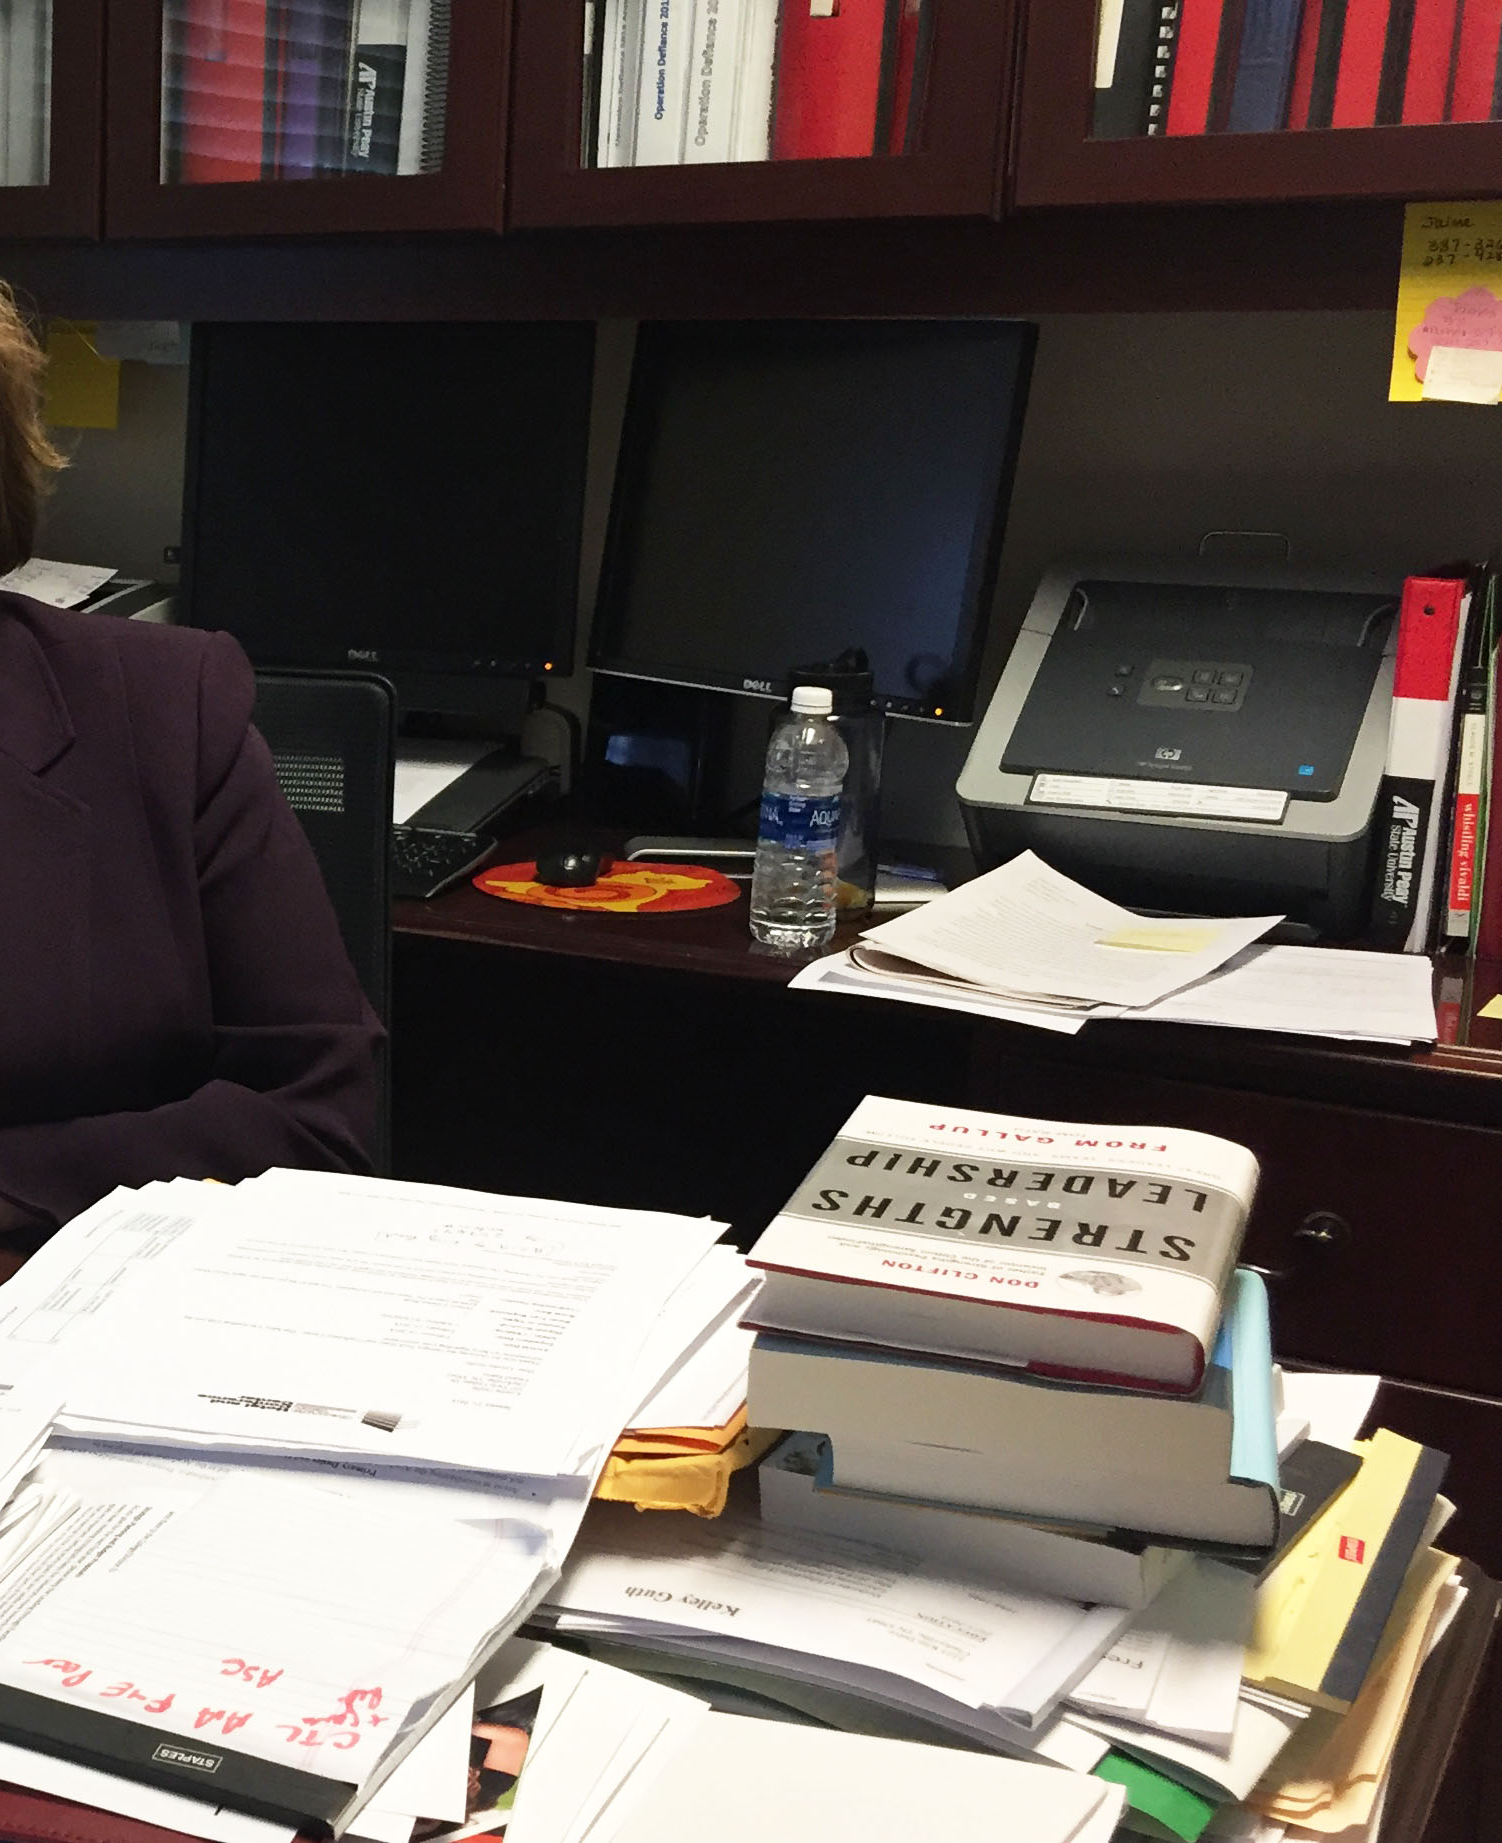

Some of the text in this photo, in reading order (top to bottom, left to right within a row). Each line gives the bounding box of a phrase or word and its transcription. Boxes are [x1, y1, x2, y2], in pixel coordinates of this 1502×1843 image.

[657, 20, 669, 67] Defiance
[700, 17, 717, 77] Defiance
[362, 89, 376, 127] Austin
[655, 68, 665, 120] Operation
[694, 79, 711, 146] Operation
[358, 129, 373, 158] Peay
[347, 648, 379, 662] DELL
[742, 677, 772, 693] DELL
[1380, 824, 1401, 902] State University
[1398, 825, 1417, 870] Austin
[1457, 802, 1474, 902] whistling vivaldi
[1391, 871, 1412, 906] Peay
[929, 1123, 1168, 1153] FROM GALLUP
[845, 1149, 1208, 1214] LEADERSHIP
[963, 1191, 1061, 1210] BASED
[811, 1188, 1197, 1263] STRENGTHS
[881, 1259, 1040, 1289] DON CLIFTON
[623, 1584, 743, 1619] Kelley Guth
[218, 1658, 284, 1689] ASC
[275, 1725, 362, 1750] CTL
[159, 1748, 216, 1769] STAPLES
